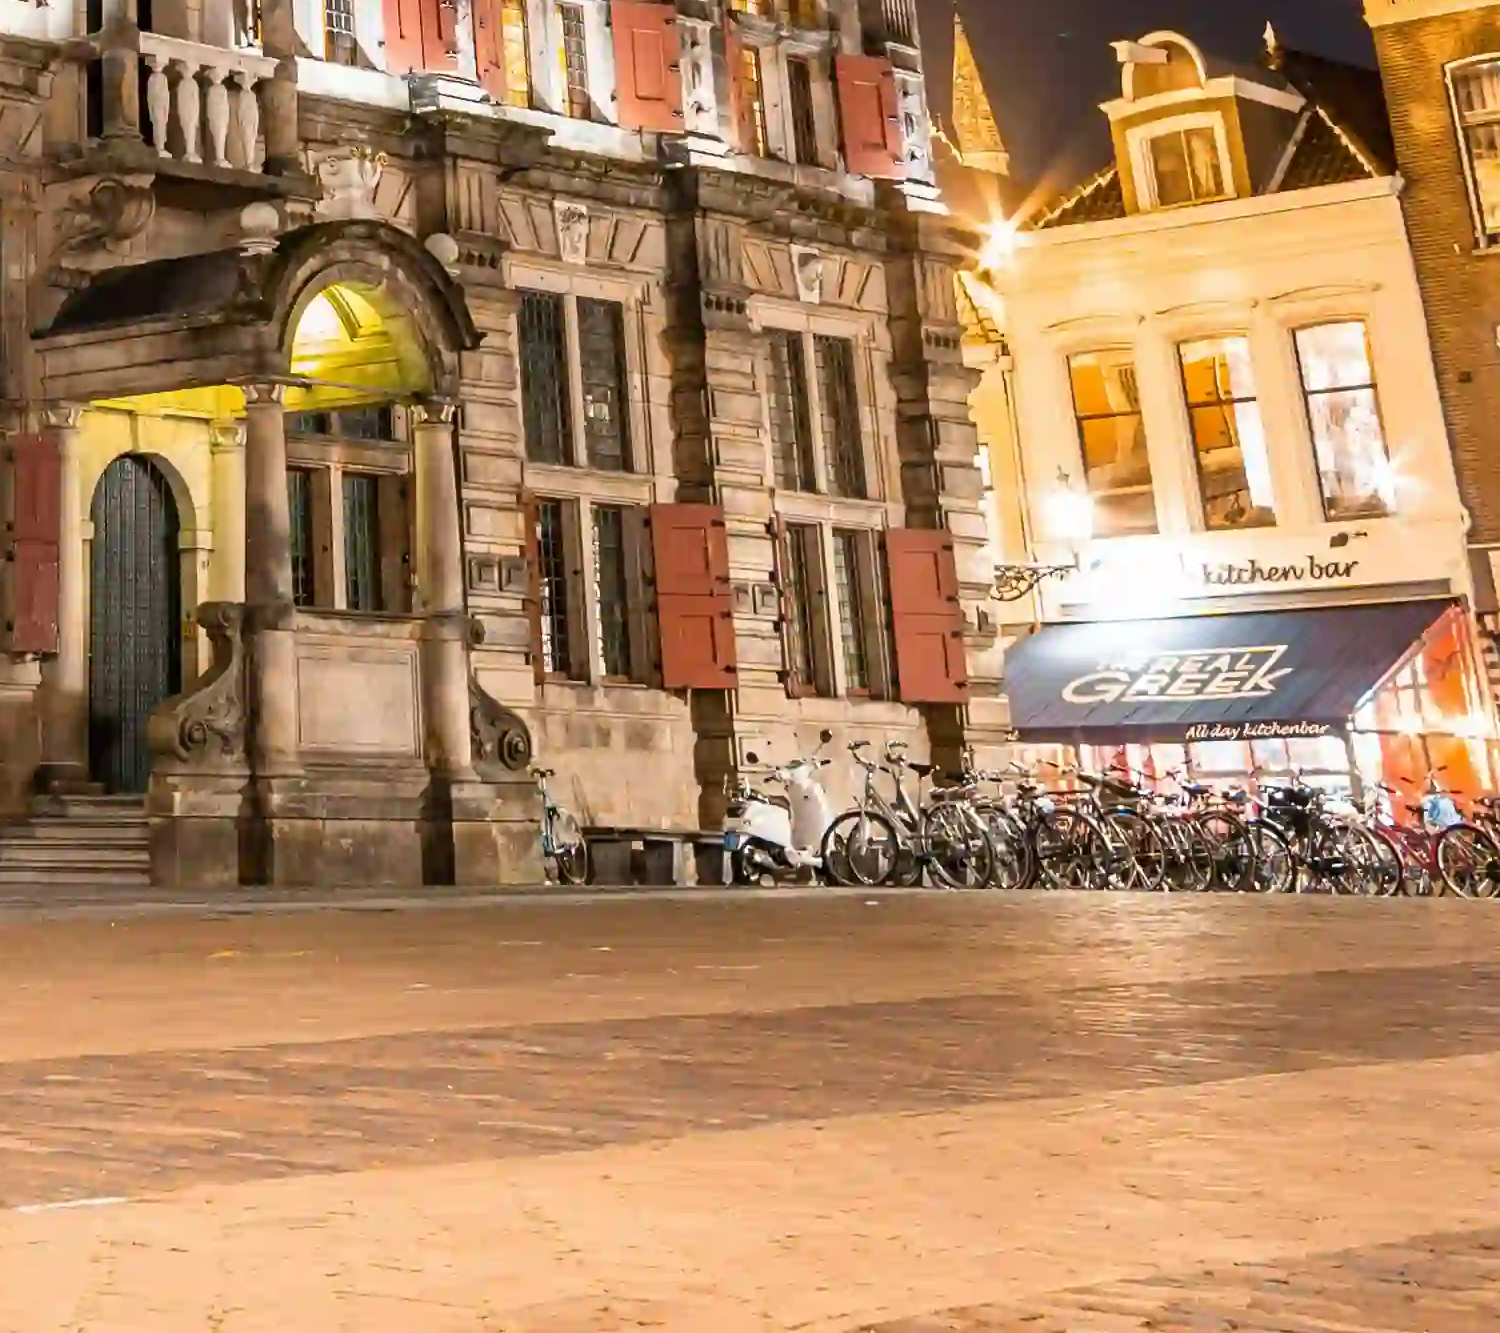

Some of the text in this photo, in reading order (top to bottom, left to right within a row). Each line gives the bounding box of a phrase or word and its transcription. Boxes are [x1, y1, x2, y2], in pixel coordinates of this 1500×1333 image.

[1202, 555, 1359, 585] kitchen bar
[1147, 653, 1255, 675] REAL
[1062, 665, 1294, 705] GREEK
[1185, 724, 1208, 739] All
[1210, 723, 1241, 741] day
